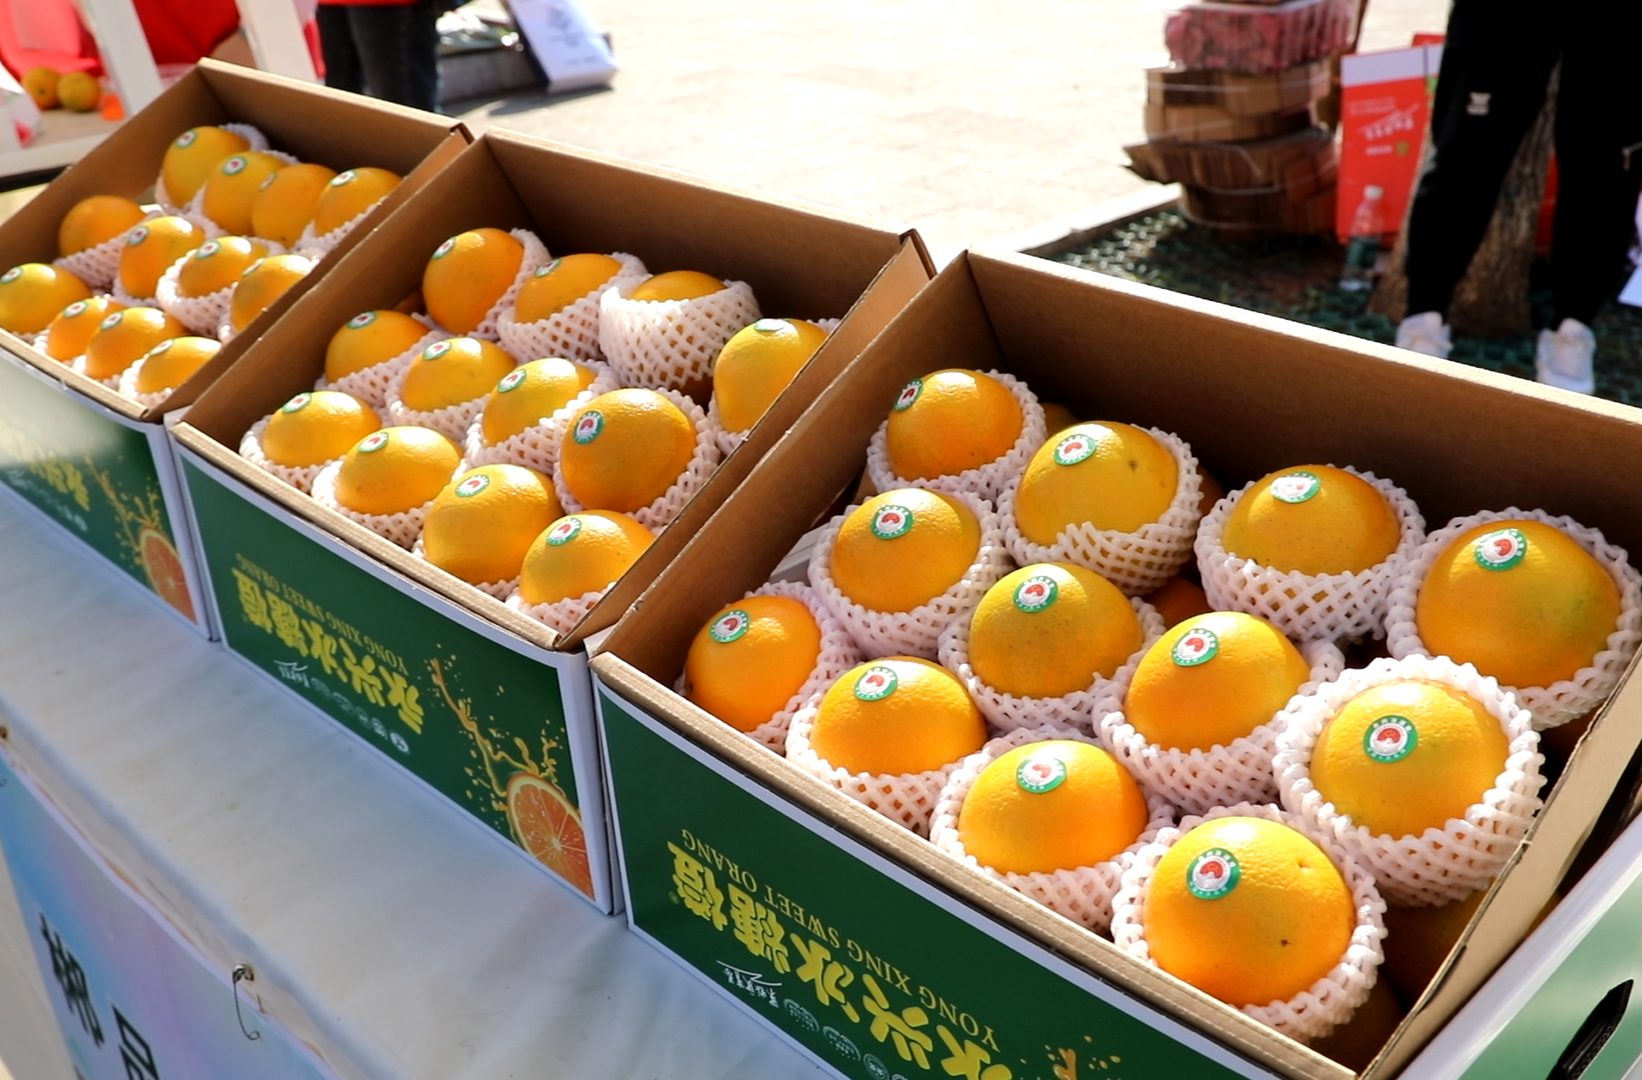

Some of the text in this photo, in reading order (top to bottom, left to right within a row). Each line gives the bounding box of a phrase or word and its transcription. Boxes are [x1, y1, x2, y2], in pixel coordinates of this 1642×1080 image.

[231, 567, 425, 735] 永兴冰糖橙
[326, 611, 364, 647] XING
[364, 636, 409, 676] YONG
[681, 829, 758, 893] ORANG
[764, 884, 841, 949] SWEET
[846, 939, 913, 997] XING
[919, 985, 1000, 1053] YONG
